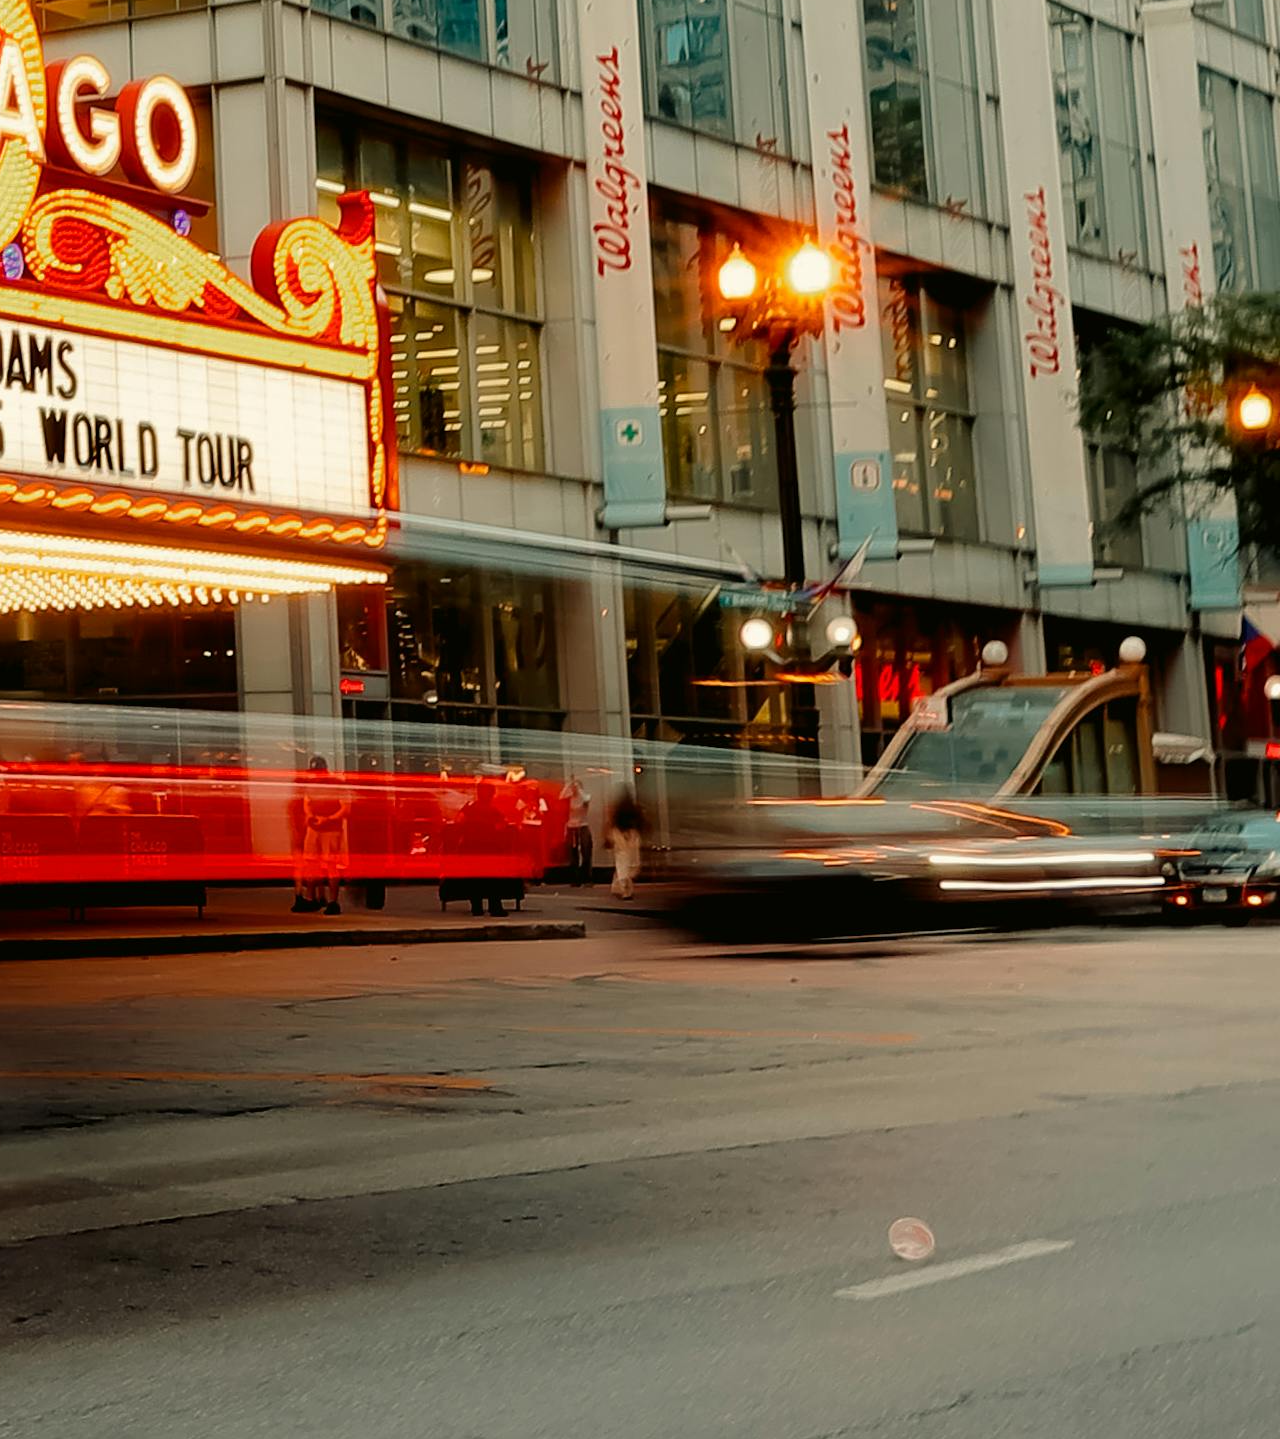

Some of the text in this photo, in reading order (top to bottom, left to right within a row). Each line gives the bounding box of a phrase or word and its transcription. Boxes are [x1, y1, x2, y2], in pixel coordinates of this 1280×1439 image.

[593, 46, 641, 278] Walgreens
[827, 123, 871, 334] Walgreens
[1024, 185, 1065, 379] Walgreens
[41, 408, 159, 480] WORLD
[177, 428, 255, 495] TOUR
